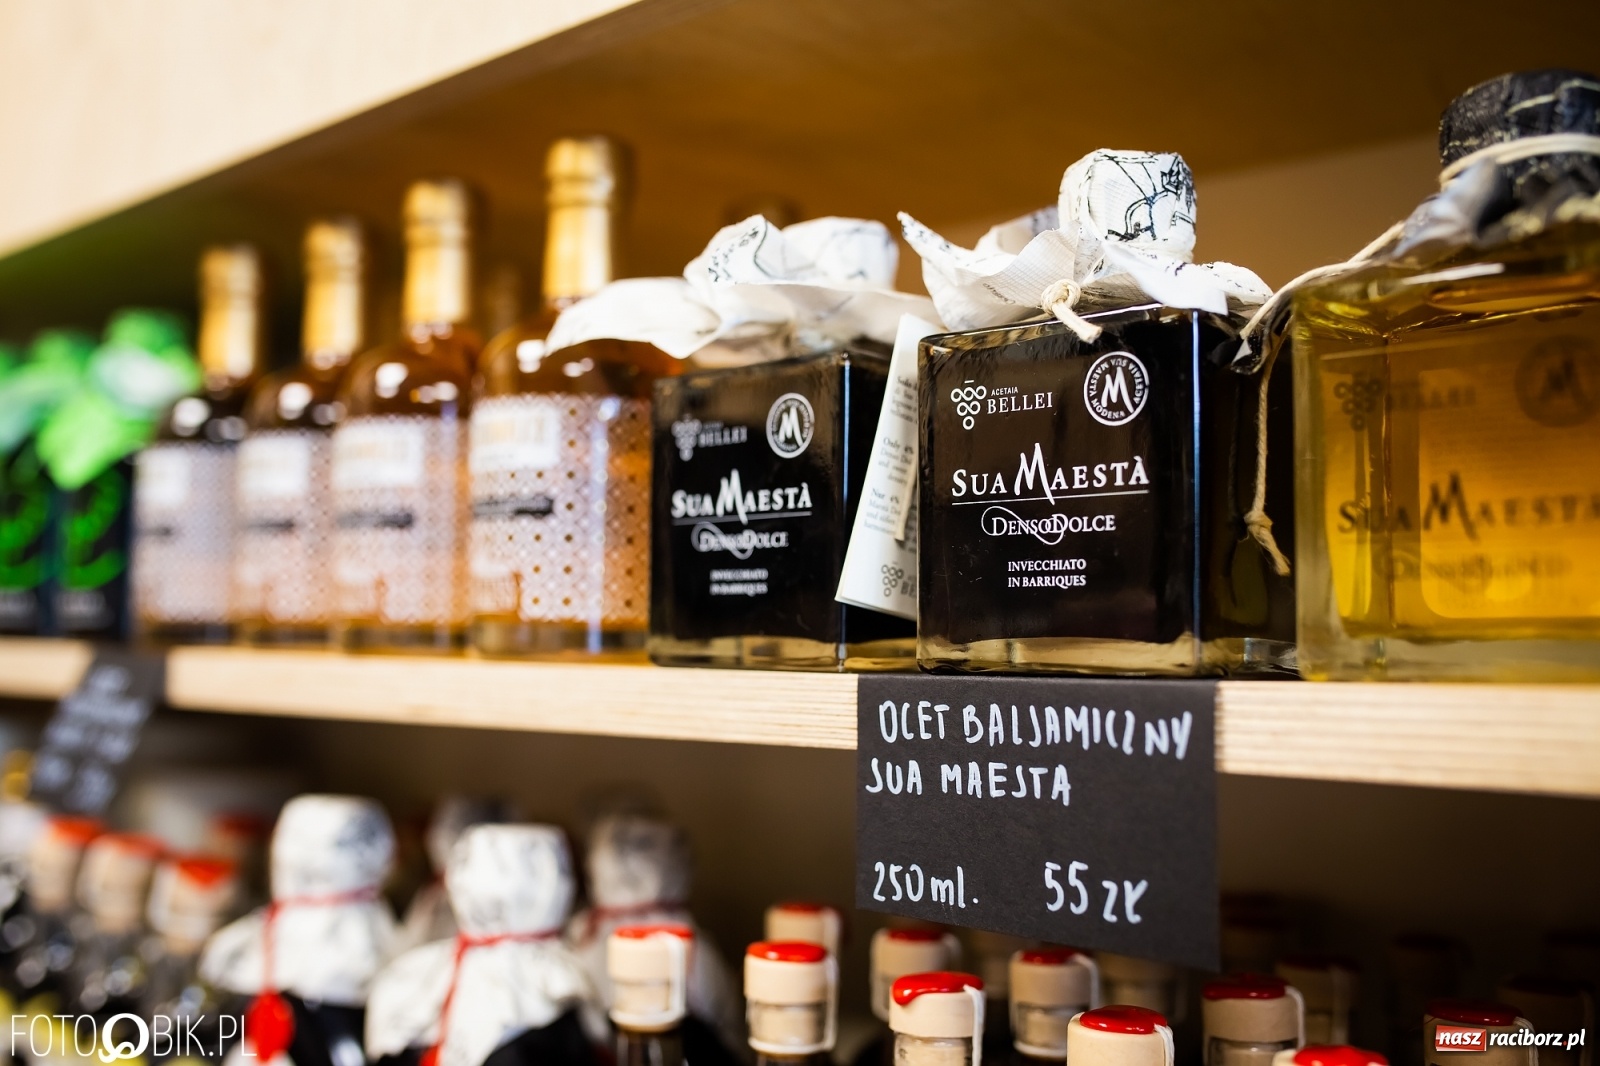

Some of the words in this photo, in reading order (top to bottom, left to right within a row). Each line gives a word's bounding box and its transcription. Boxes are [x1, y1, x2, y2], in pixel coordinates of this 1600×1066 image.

[987, 391, 1053, 415] BELLEI
[991, 386, 1019, 396] ACETAIA
[952, 469, 1008, 498] SUA
[1014, 442, 1150, 506] MAESTÀ
[671, 488, 715, 519] SUA
[1007, 558, 1087, 572] INVECCHIATO
[1007, 577, 1021, 588] IN
[1022, 575, 1087, 589] BARRIQUES
[878, 700, 950, 744] OCET
[865, 757, 923, 796] SUA
[940, 760, 1072, 807] MAESTA
[873, 861, 924, 902] 250
[1044, 860, 1089, 915] 55
